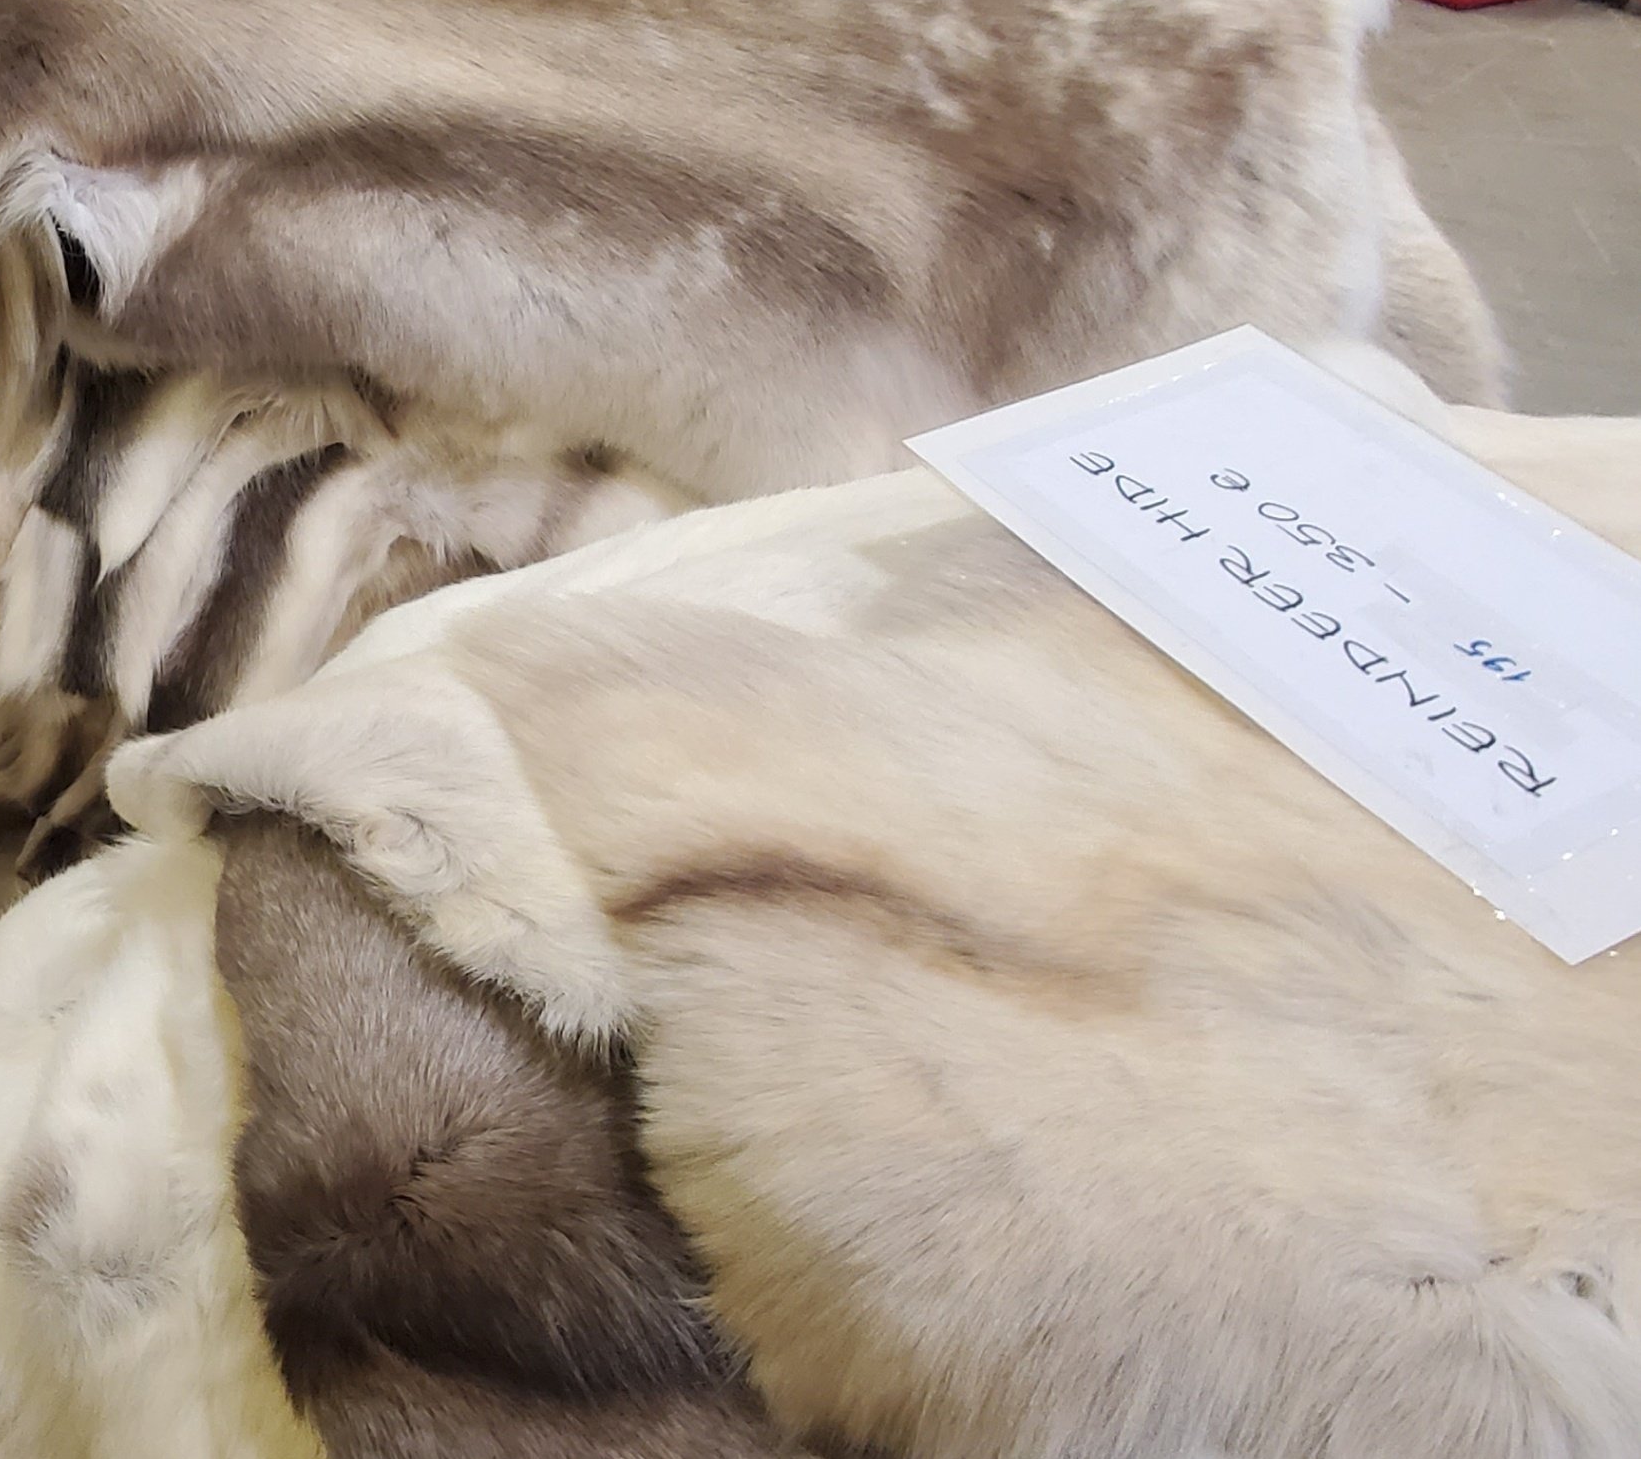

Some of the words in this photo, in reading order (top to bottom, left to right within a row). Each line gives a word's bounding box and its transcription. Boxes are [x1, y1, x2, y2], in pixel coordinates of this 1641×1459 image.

[1069, 450, 1211, 542] HIDE
[1257, 501, 1377, 574] 350
[1218, 544, 1558, 798] REINDEER
[1452, 638, 1532, 683] 195
